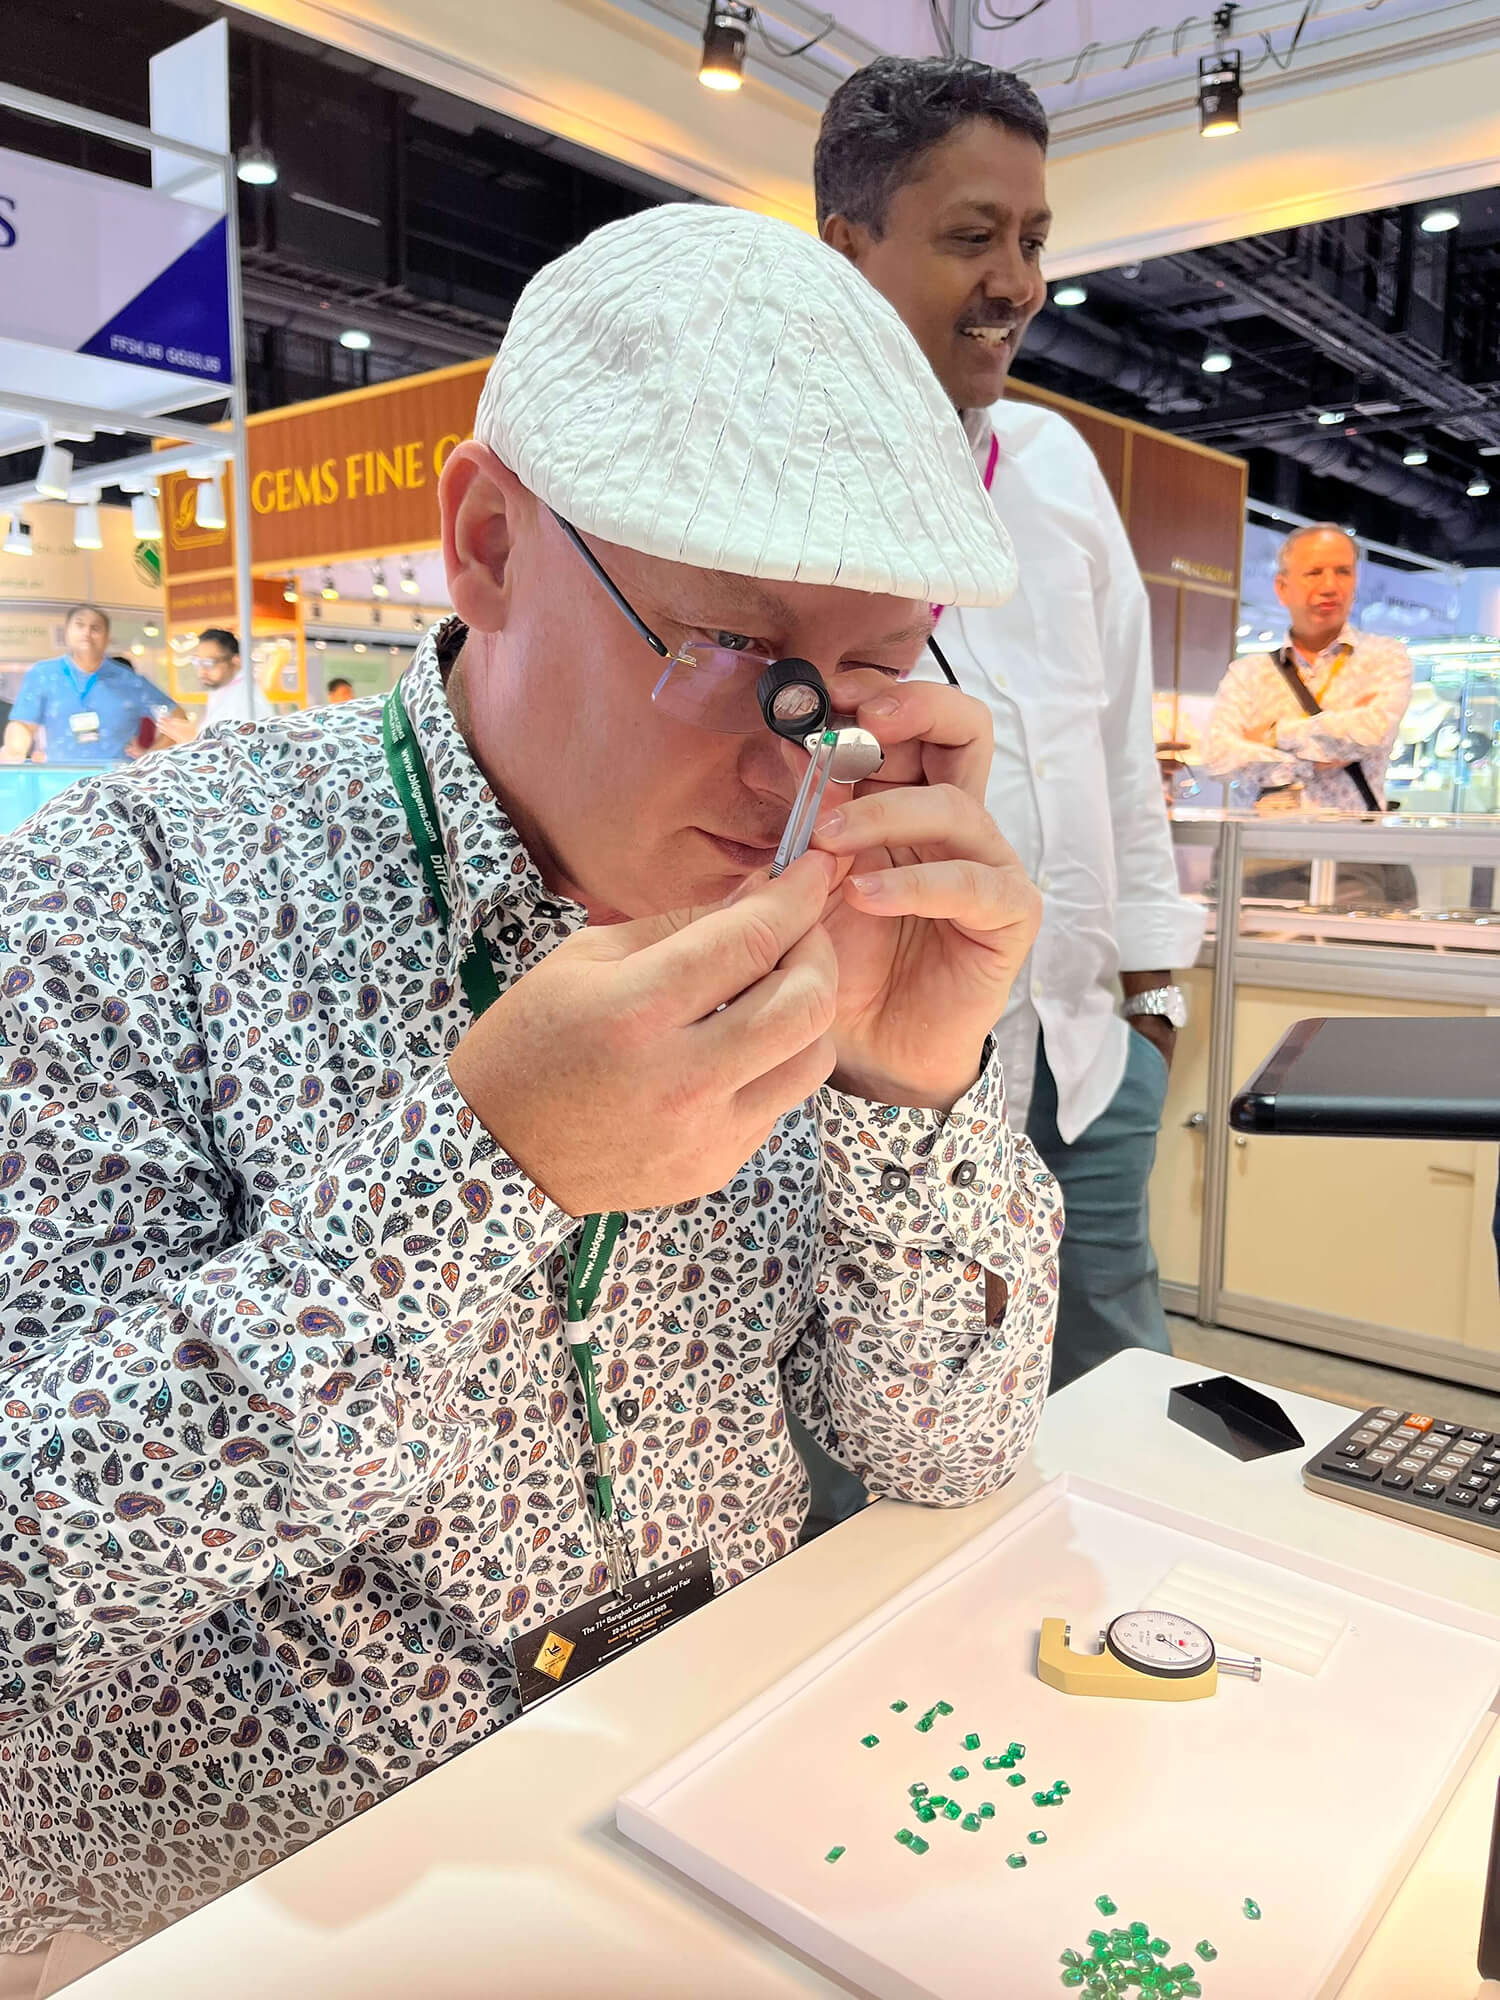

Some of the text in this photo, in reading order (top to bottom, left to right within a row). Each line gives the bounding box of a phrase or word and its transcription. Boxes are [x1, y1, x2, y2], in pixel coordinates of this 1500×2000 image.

[251, 458, 339, 514] GEMS
[345, 441, 425, 499] FINE
[401, 748, 438, 842] www.bkkgems.com
[581, 1625, 595, 1636] The
[606, 1606, 633, 1624] Bangkok
[632, 1598, 650, 1611] Gems
[656, 1584, 679, 1600] Jewelry
[679, 1578, 691, 1589] Fair
[627, 1611, 654, 1628] FEBRUARY
